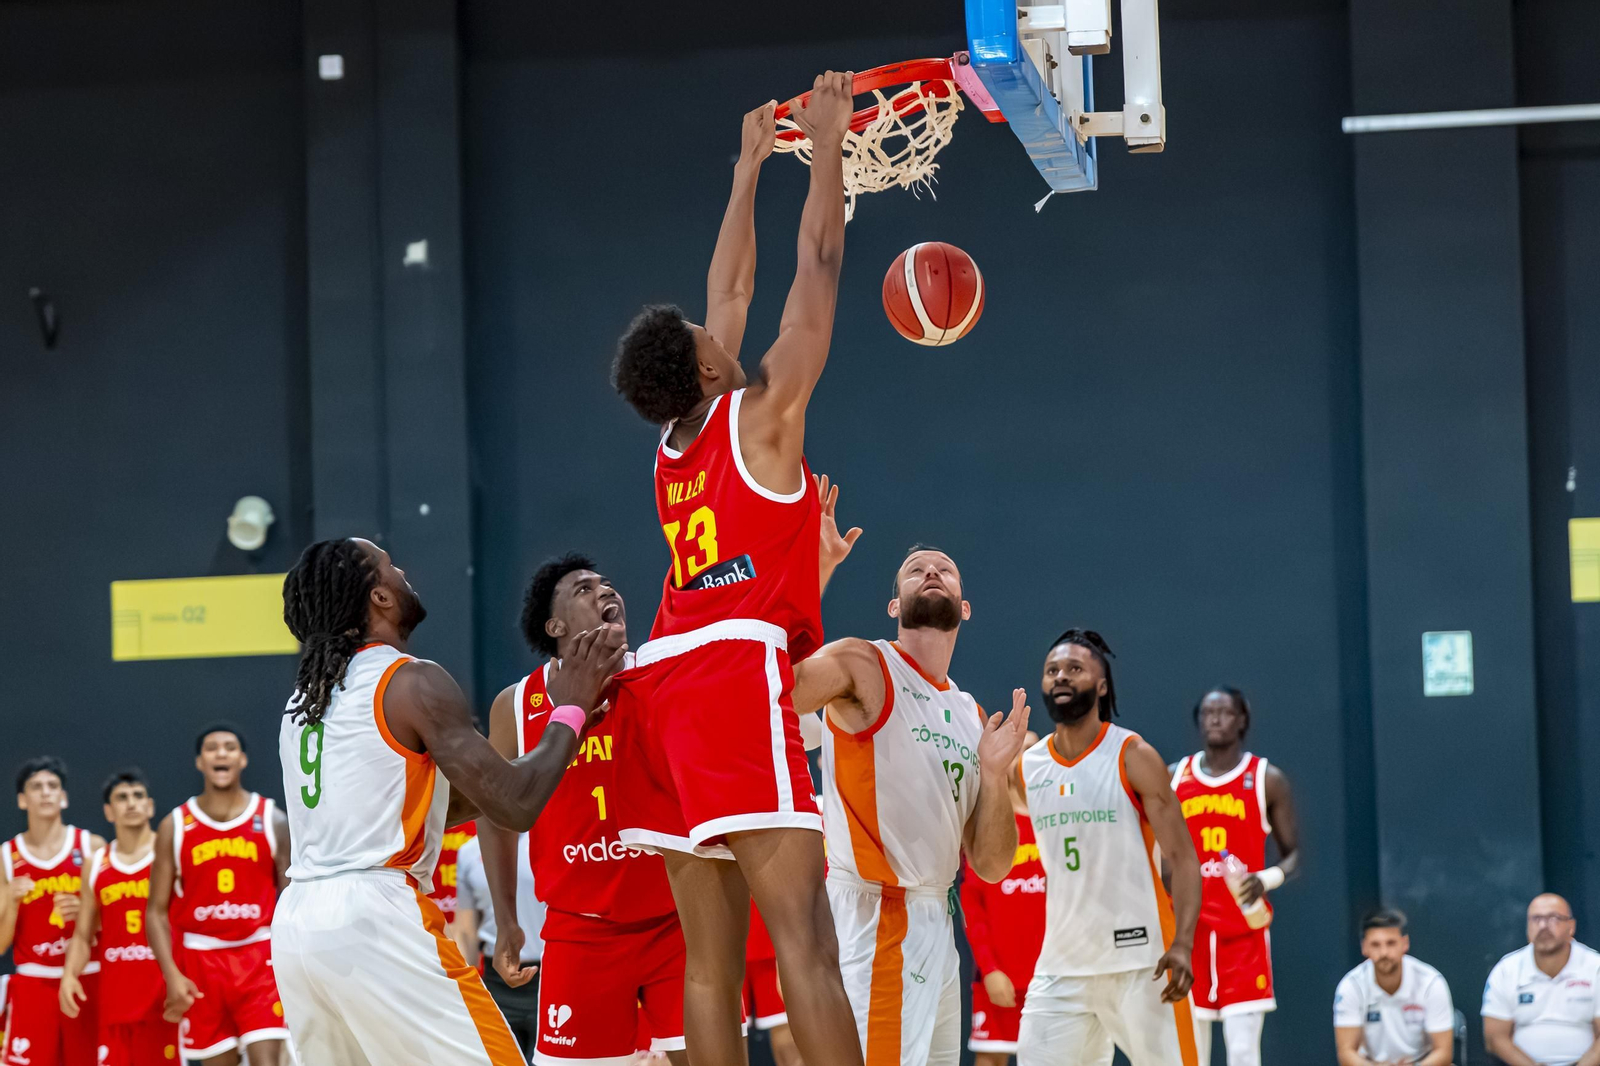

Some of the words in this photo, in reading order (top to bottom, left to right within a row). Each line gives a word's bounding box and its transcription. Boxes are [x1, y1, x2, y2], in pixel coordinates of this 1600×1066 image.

[666, 470, 706, 508] MILLER
[663, 505, 719, 588] 13
[698, 562, 751, 590] Bank
[299, 720, 325, 810] 9
[566, 735, 613, 770] PA
[590, 785, 607, 821] 1
[1035, 812, 1057, 833] ÔTE
[1060, 809, 1118, 825] D'IVOIRE
[191, 836, 258, 866] ESPAÑA
[1064, 836, 1080, 872] 5
[1200, 826, 1227, 853] 10
[23, 872, 82, 904] SPAÑA
[217, 868, 235, 894] 8
[125, 909, 142, 934] 5
[194, 900, 261, 922] endesa
